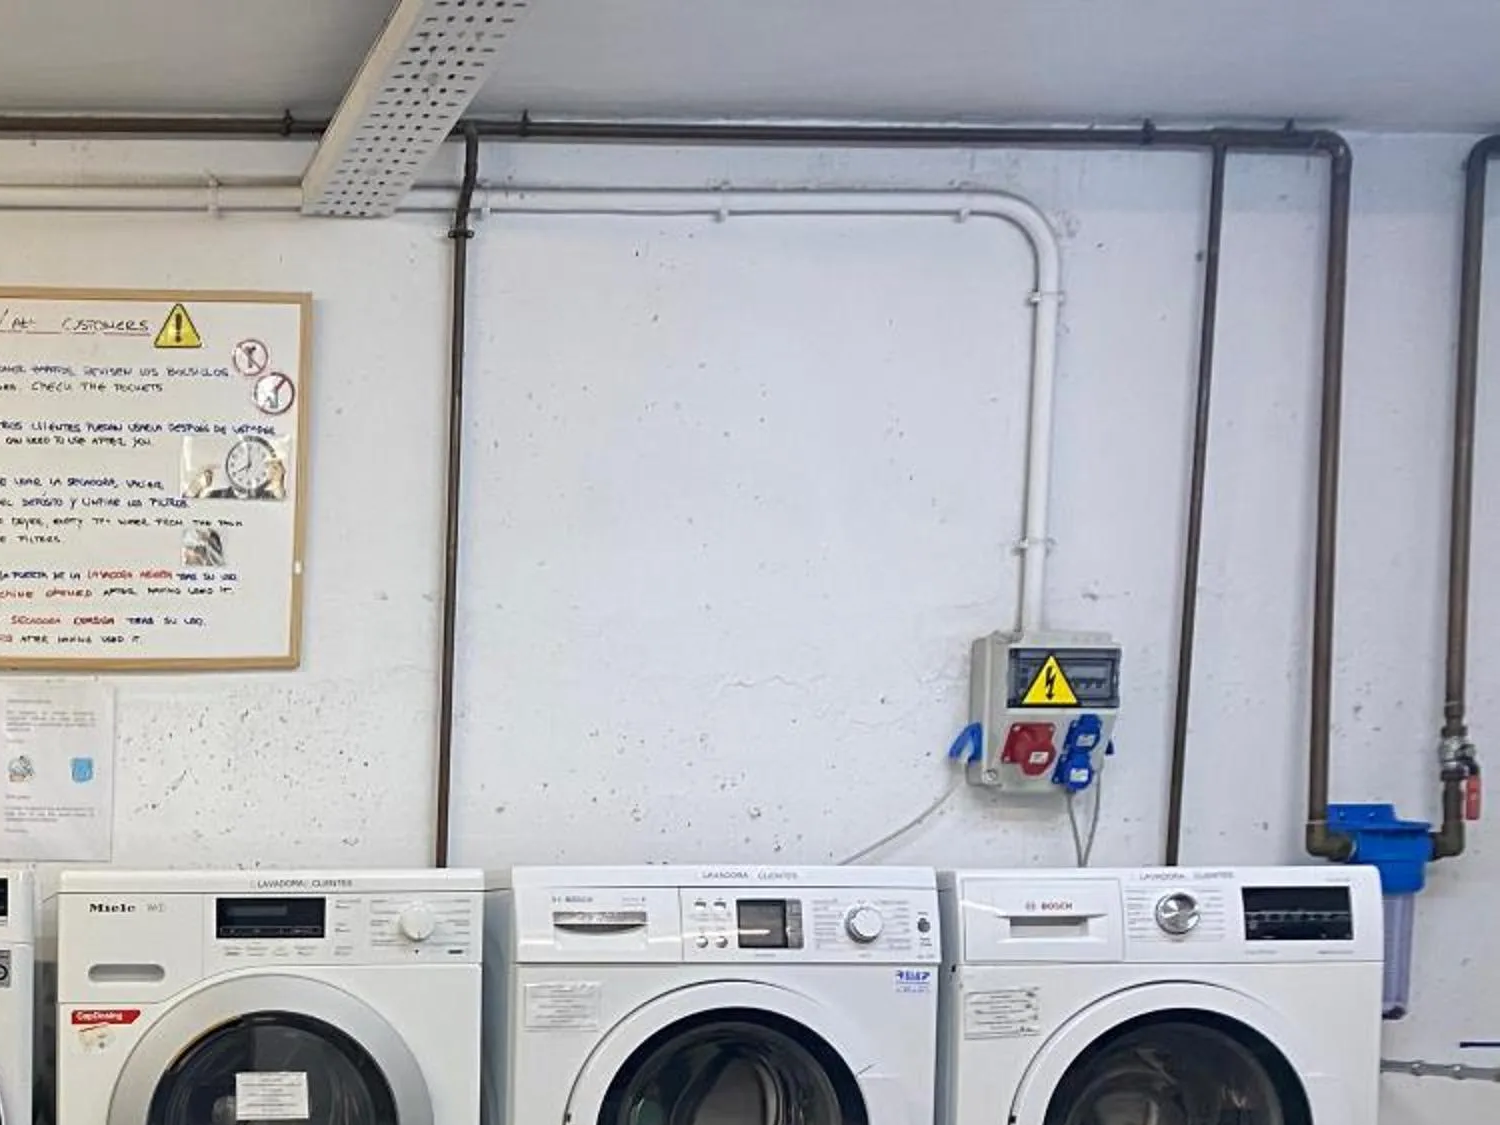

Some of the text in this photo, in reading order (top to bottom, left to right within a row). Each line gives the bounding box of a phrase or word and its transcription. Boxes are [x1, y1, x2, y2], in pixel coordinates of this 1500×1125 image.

[61, 317, 149, 331] CUSTOMERS
[81, 382, 106, 391] THE
[54, 436, 65, 445] TO
[50, 478, 62, 487] LA
[69, 498, 79, 510] Y
[53, 571, 65, 580] DE
[257, 879, 303, 888] LAVADORA
[89, 903, 136, 913] Miele
[1041, 902, 1073, 911] BOSCH
